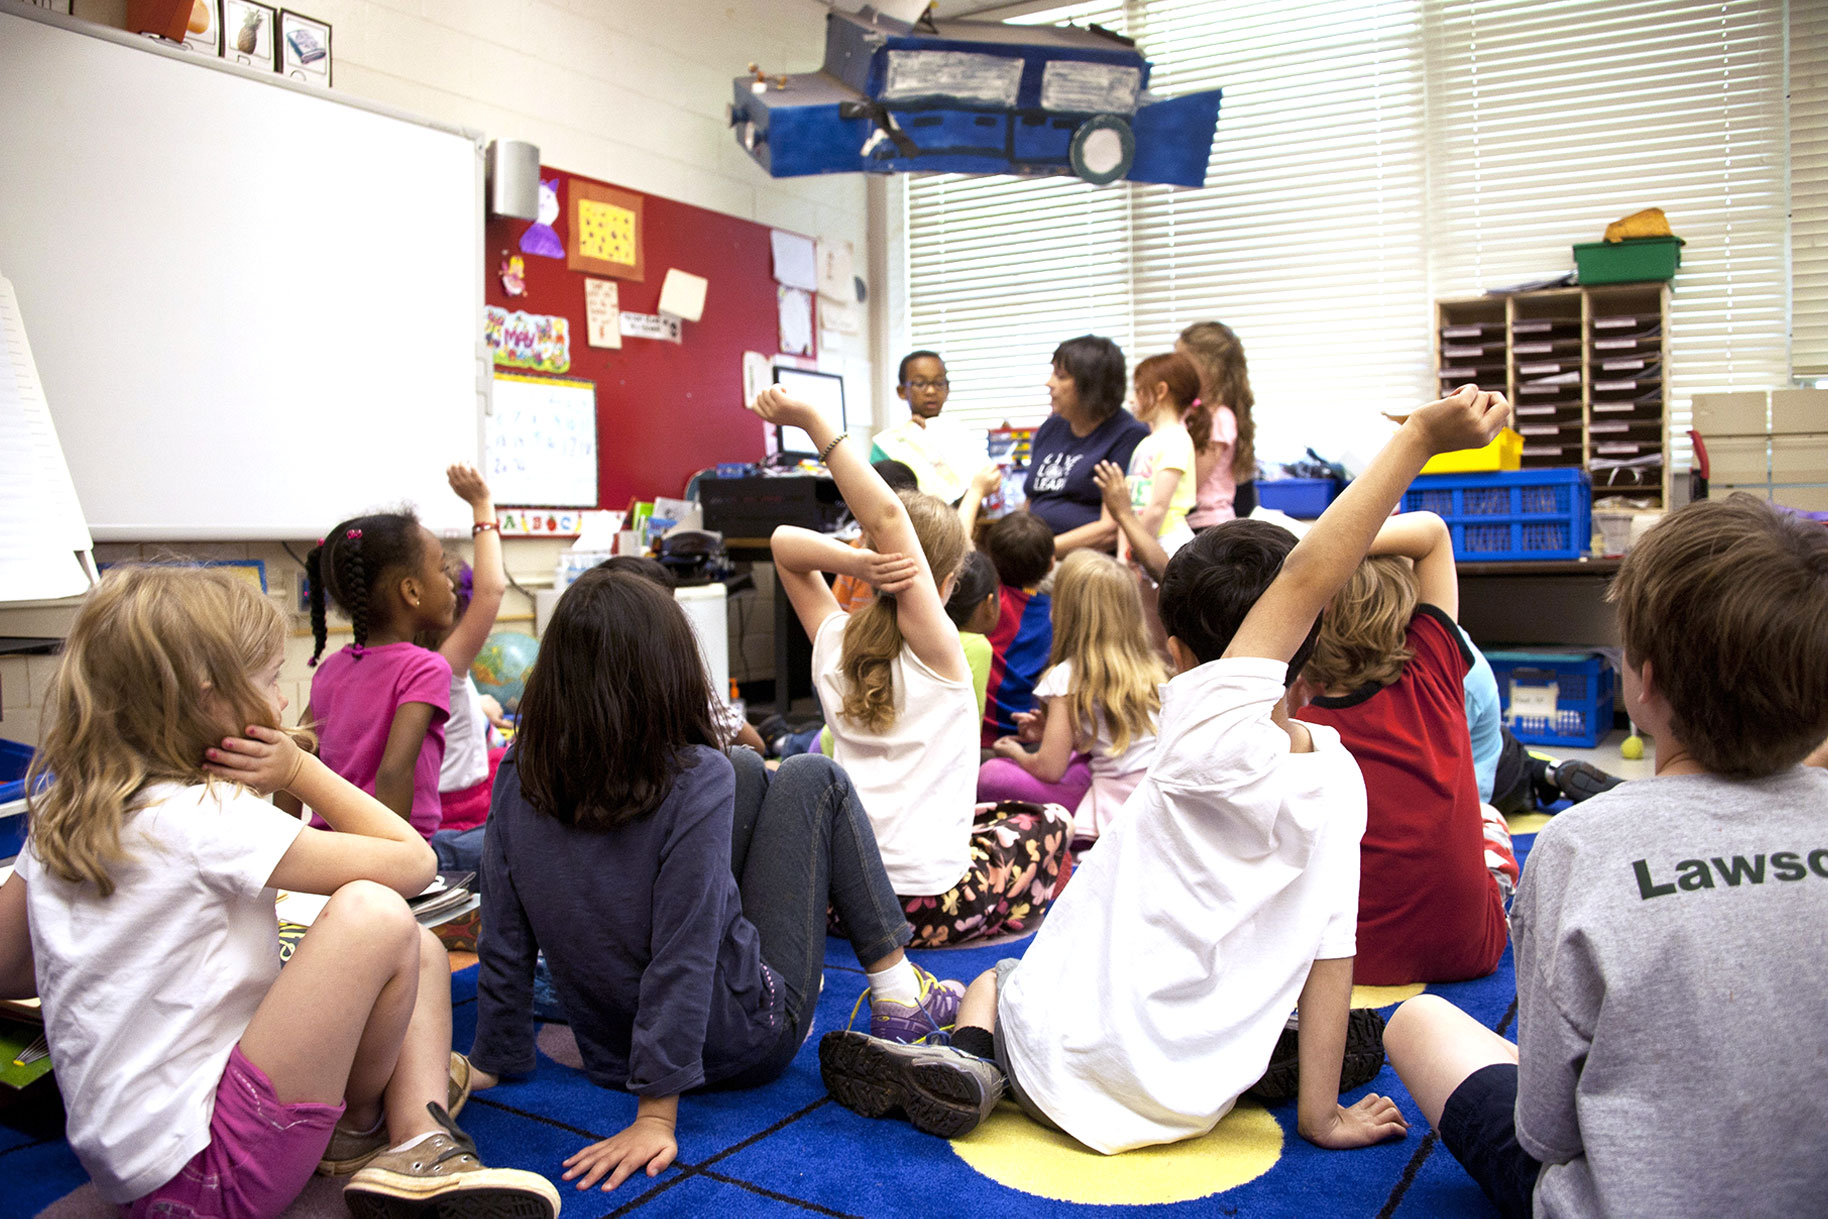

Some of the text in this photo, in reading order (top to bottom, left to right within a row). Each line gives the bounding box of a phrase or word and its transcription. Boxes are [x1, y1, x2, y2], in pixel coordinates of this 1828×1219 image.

[503, 514, 571, 531] A B C
[1632, 848, 1828, 900] Lawso
